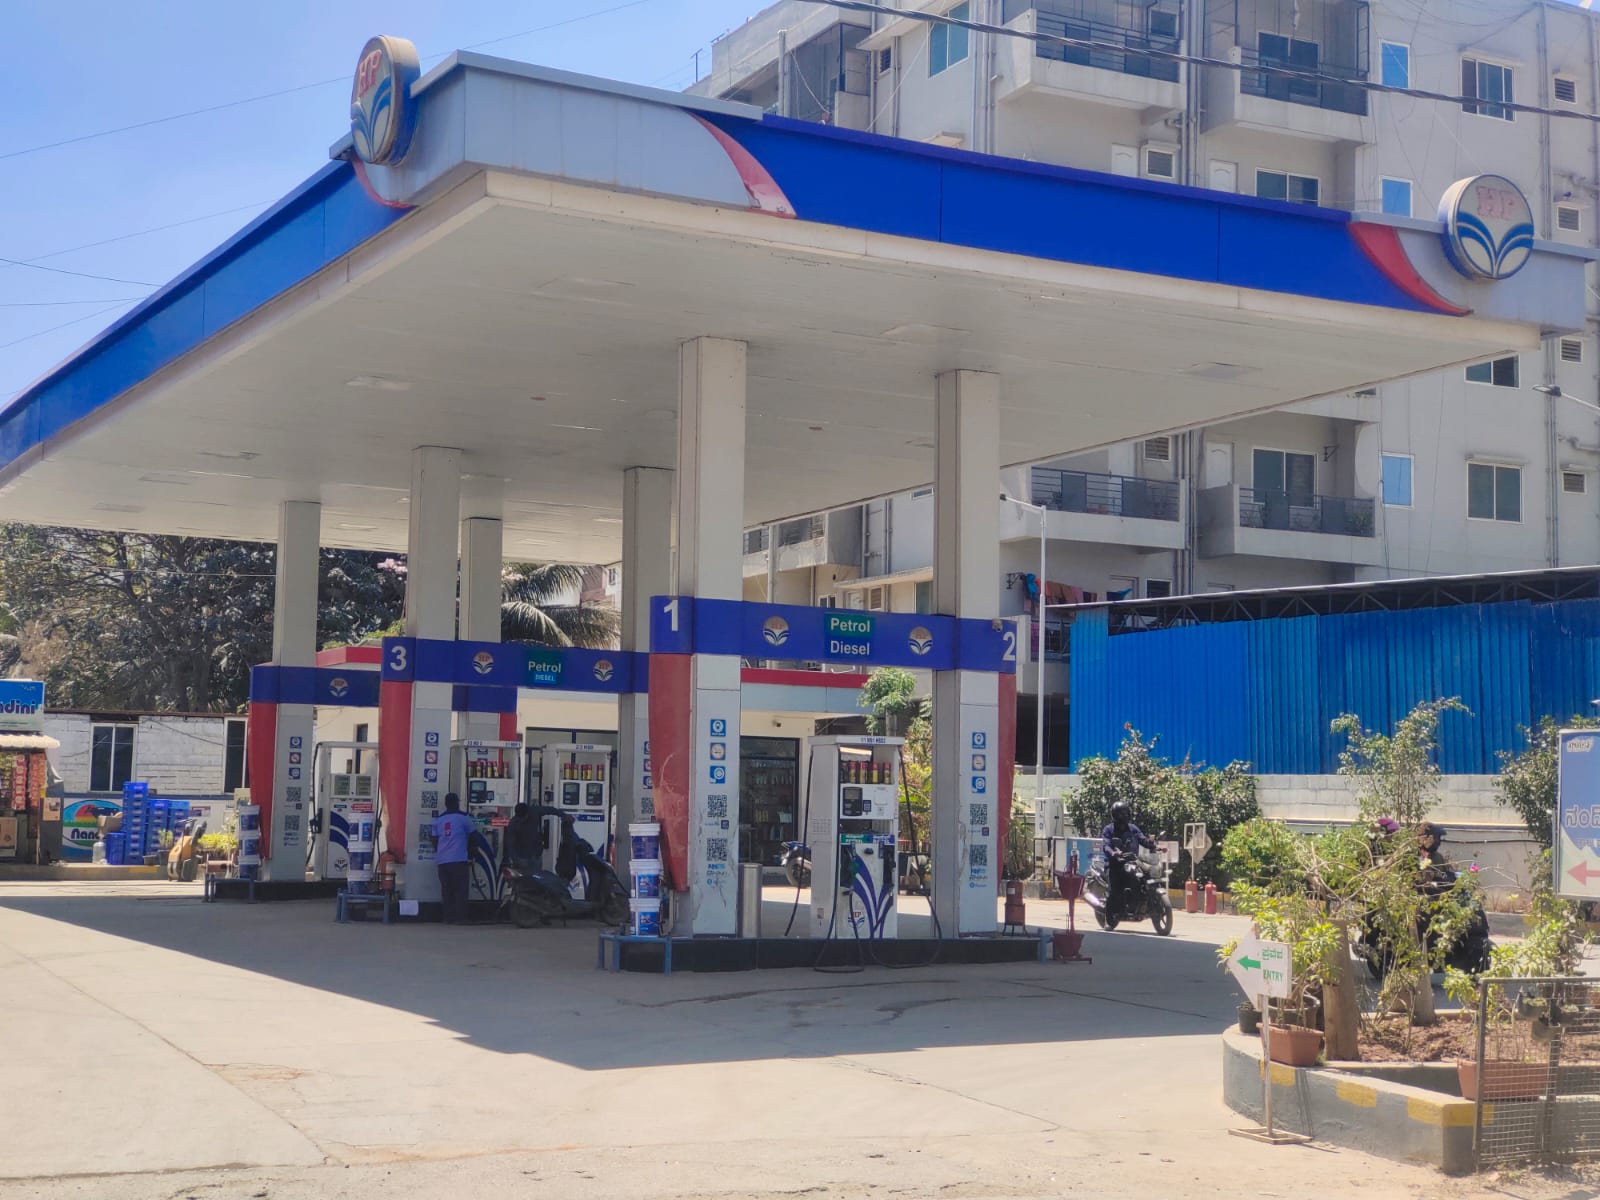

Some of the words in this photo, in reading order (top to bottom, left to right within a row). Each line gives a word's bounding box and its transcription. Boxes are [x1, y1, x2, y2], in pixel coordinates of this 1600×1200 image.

[1477, 186, 1522, 221] HP
[664, 600, 679, 631] 1
[831, 618, 870, 633] Petrol
[830, 640, 870, 655] Diesel
[1003, 631, 1016, 661] 2
[390, 645, 407, 671] 3
[528, 661, 562, 673] Petrol
[1263, 969, 1283, 982] ENTRY
